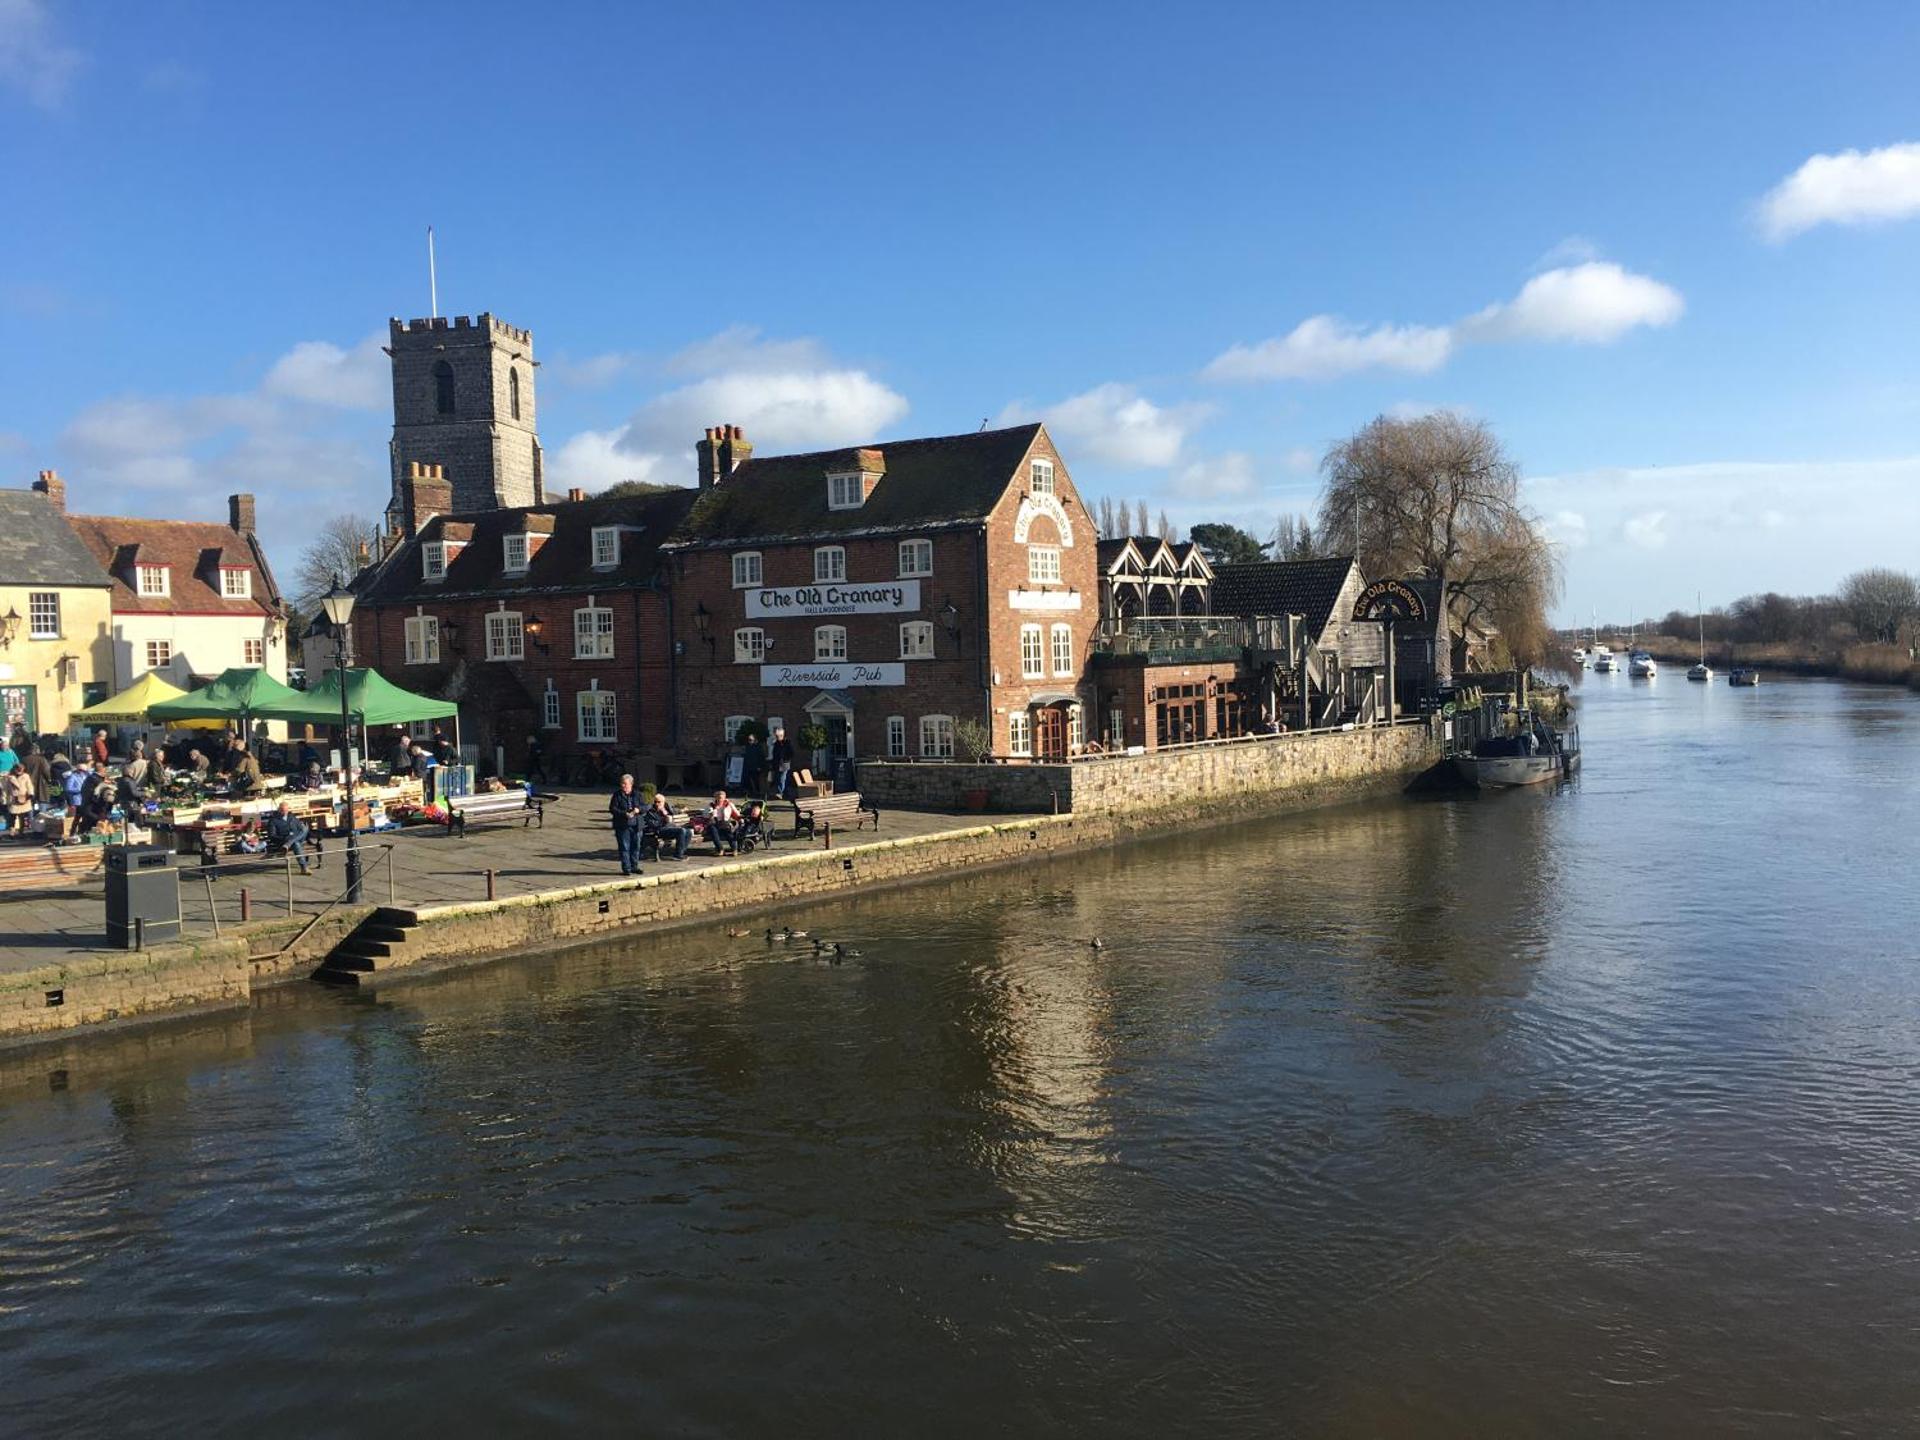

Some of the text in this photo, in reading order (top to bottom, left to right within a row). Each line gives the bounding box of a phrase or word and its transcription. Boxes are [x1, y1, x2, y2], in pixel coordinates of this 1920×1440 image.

[759, 586, 904, 608] The Old Granary
[1354, 581, 1421, 617] The Old Granary
[778, 666, 882, 683] Riverside Pub
